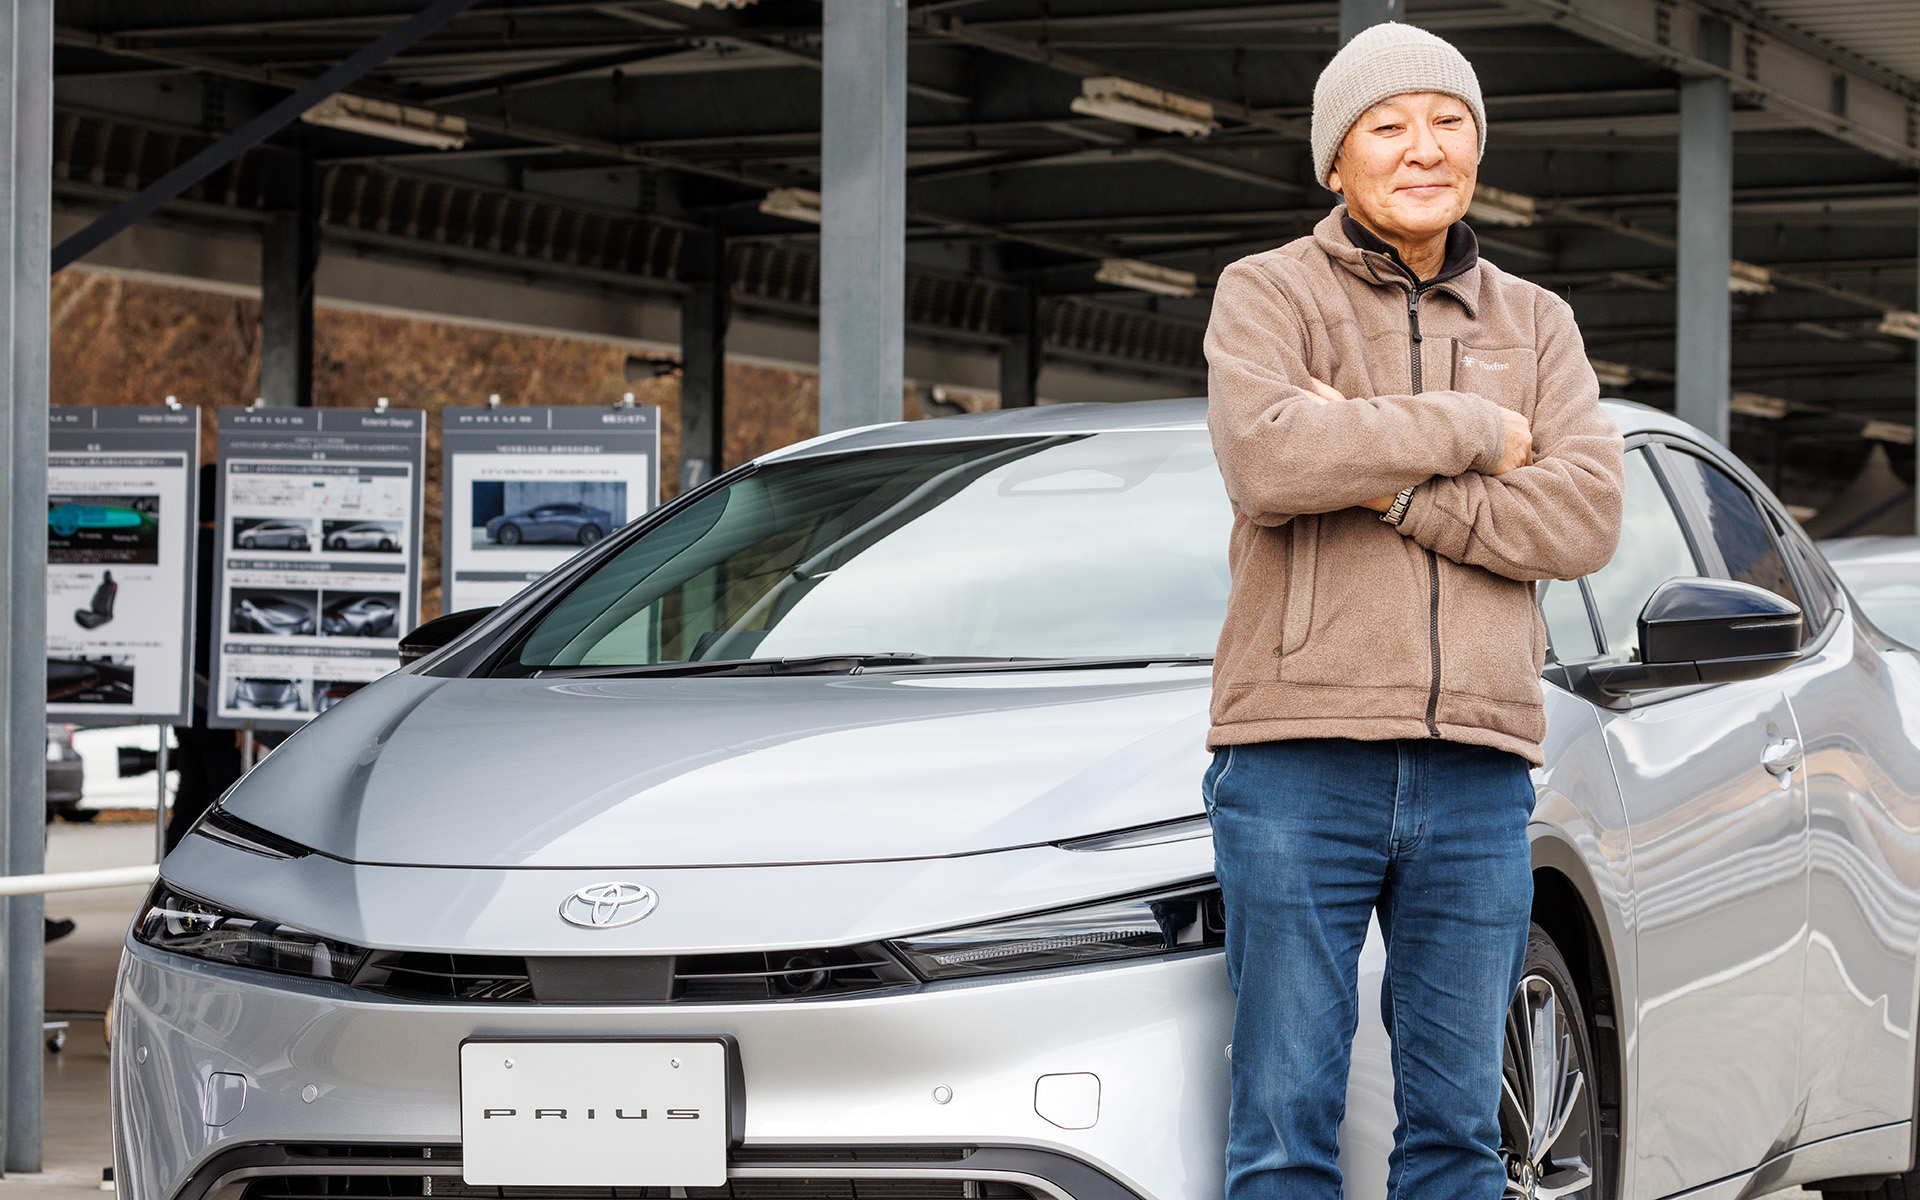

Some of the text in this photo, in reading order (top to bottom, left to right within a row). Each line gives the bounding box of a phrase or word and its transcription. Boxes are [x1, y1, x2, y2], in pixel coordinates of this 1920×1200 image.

[1479, 361, 1509, 371] Foxfire
[686, 460, 704, 488] 7
[483, 1109, 700, 1119] PRIUS
